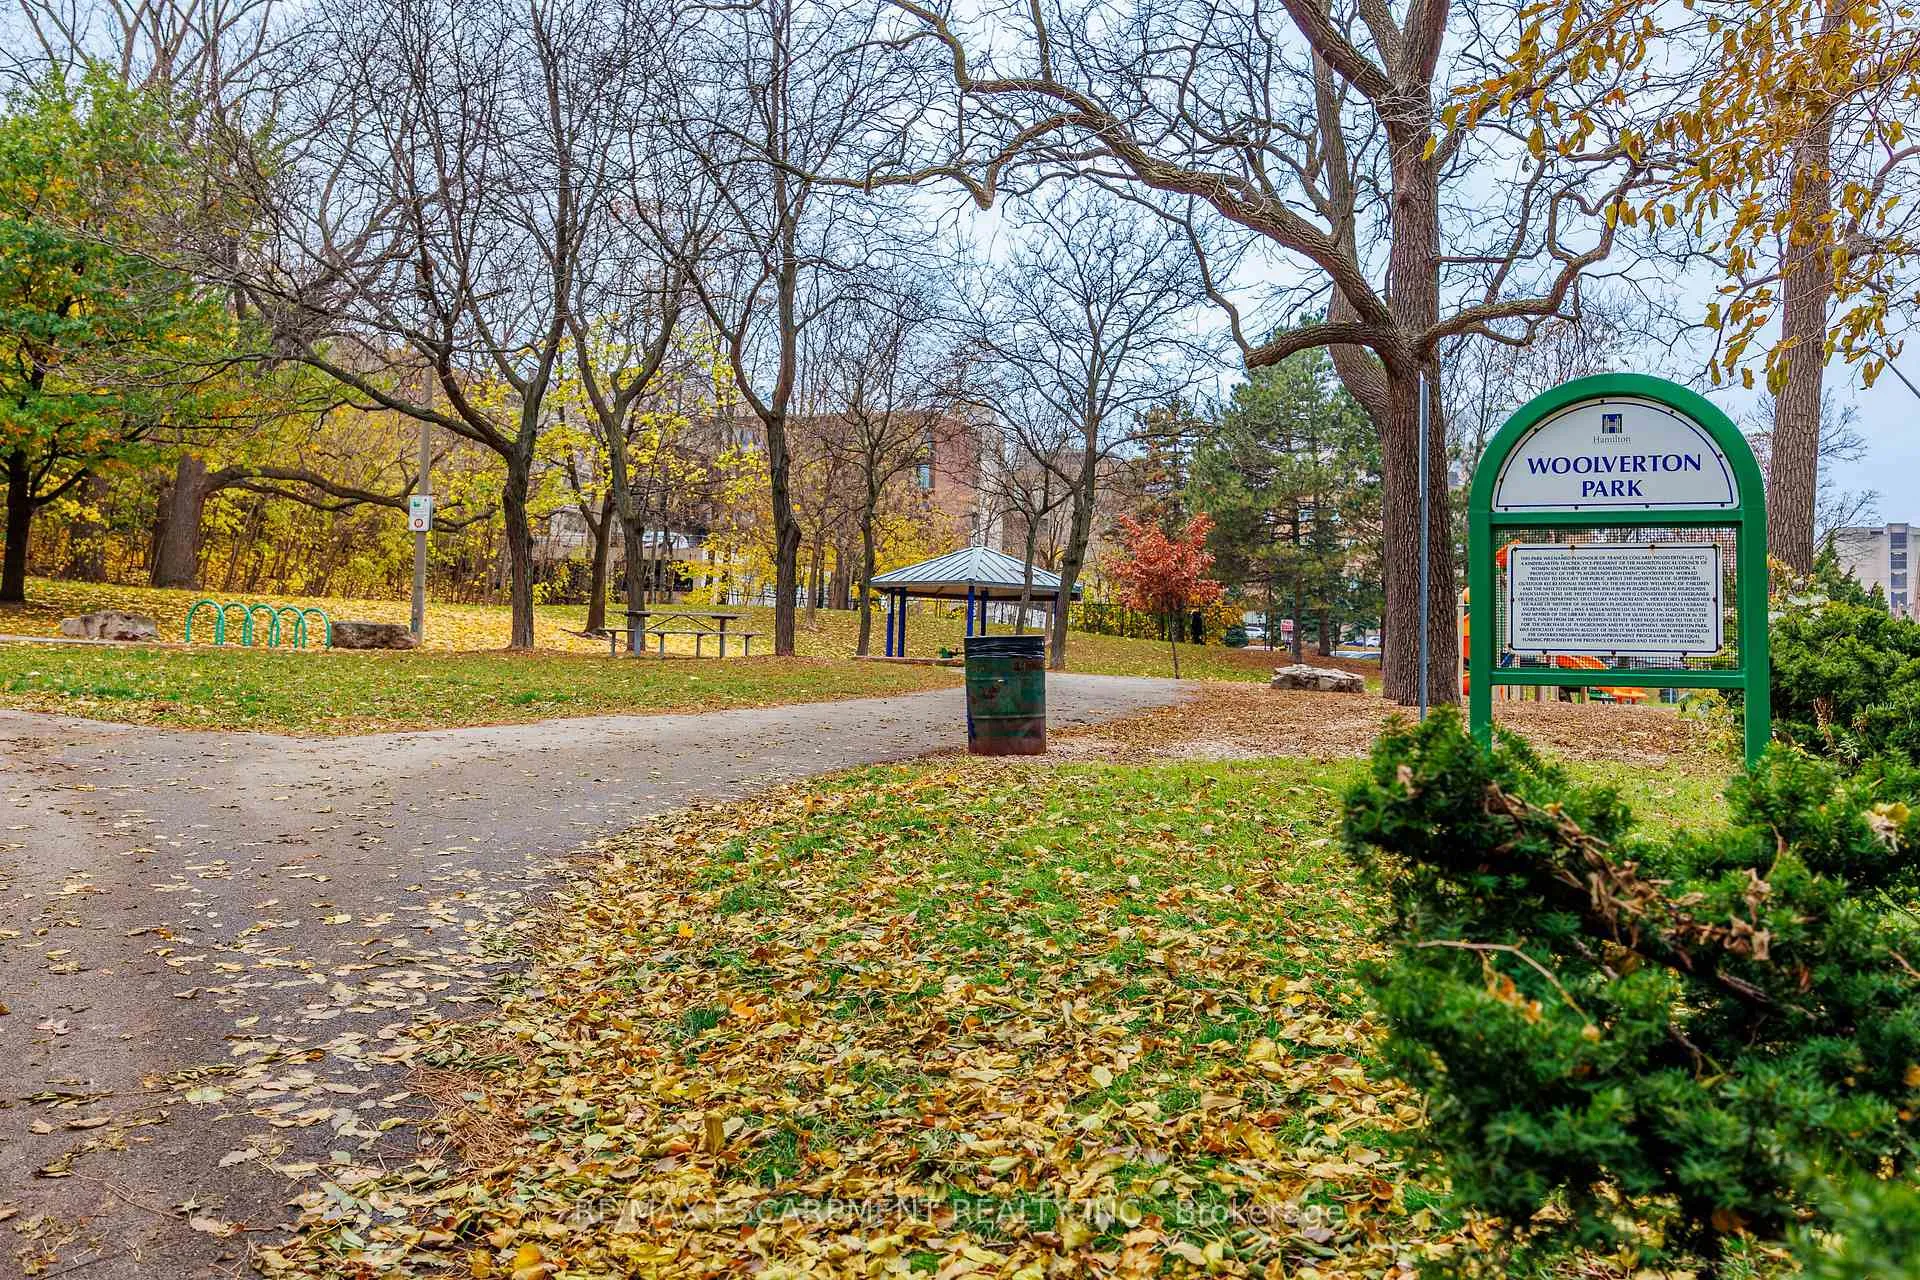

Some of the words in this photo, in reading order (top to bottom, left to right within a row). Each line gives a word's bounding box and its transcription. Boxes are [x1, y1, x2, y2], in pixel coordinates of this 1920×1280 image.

[1593, 435, 1632, 445] Hamilton
[1527, 454, 1702, 475] WOOLVERTON
[1582, 479, 1644, 497] PARK
